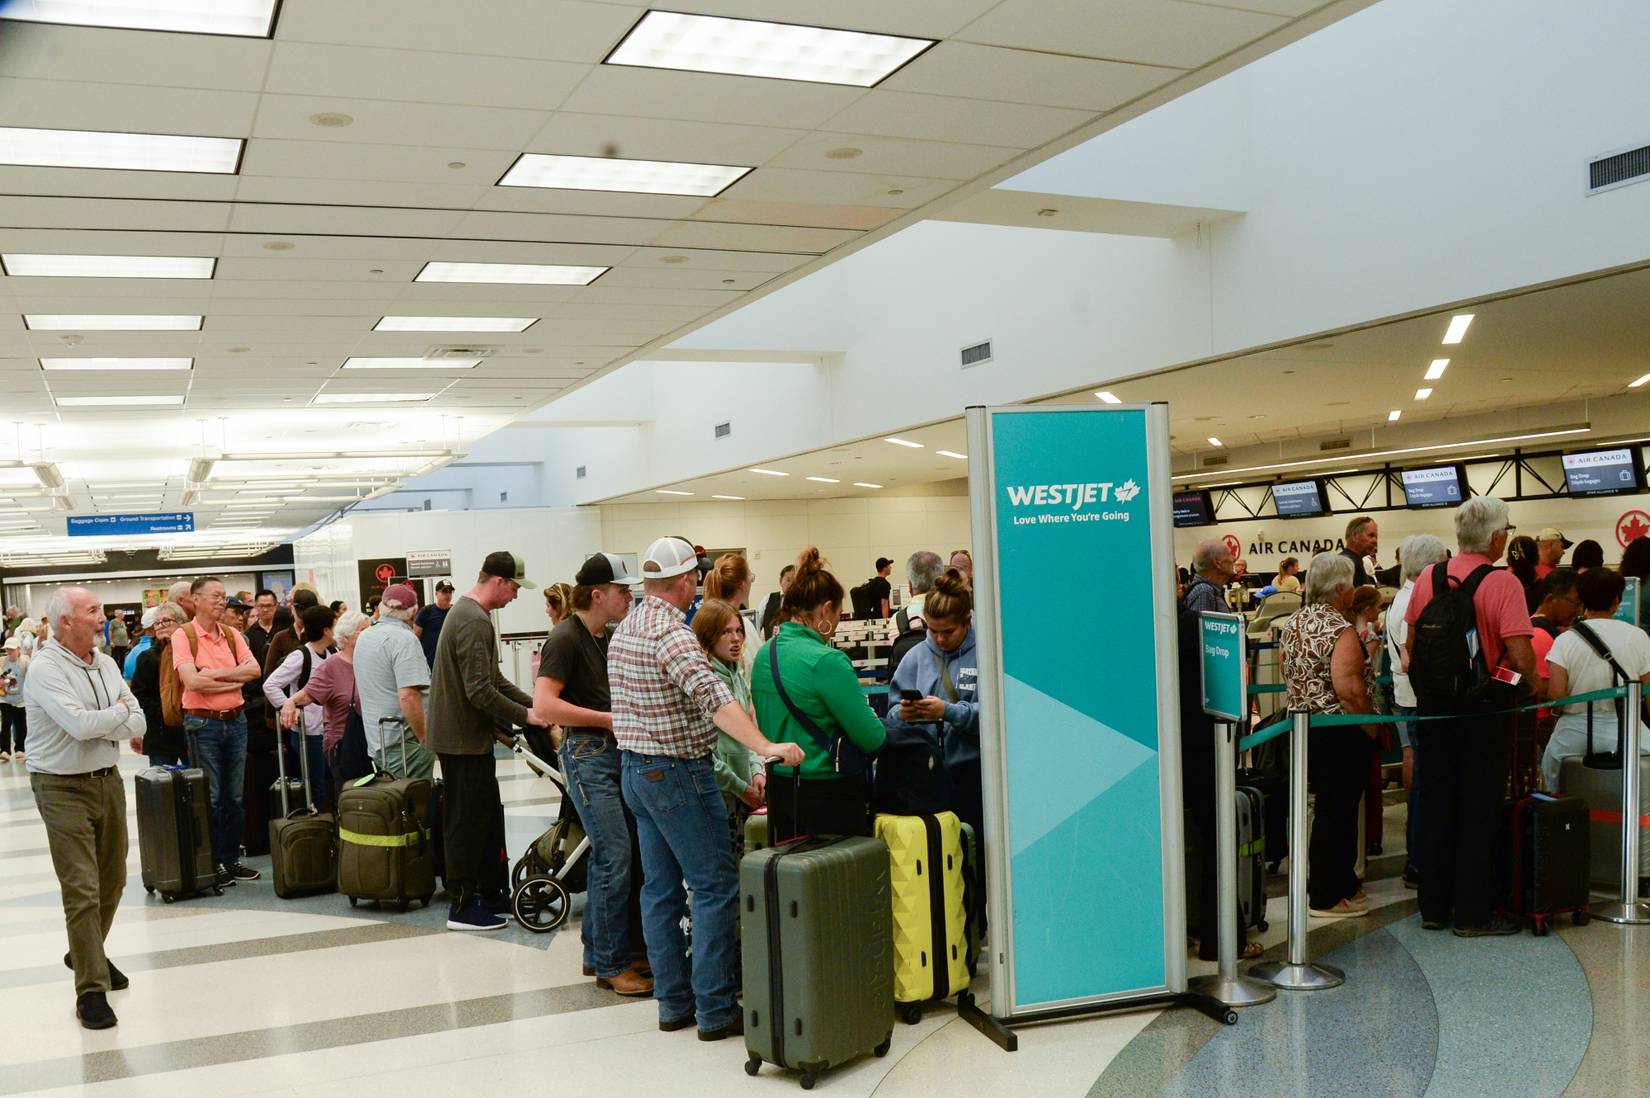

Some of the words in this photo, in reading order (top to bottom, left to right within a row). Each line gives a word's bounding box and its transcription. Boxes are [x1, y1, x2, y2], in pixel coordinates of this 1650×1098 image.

[1592, 453, 1627, 463] CANADA
[1425, 471, 1454, 479] CANADA
[1291, 484, 1314, 492] CANADA
[1006, 482, 1114, 511] WESTJET
[1013, 515, 1037, 525] Love
[1038, 513, 1070, 524] Where
[1102, 510, 1130, 522] Going
[1249, 541, 1274, 555] AIR
[1277, 538, 1345, 554] CANADA
[1204, 621, 1230, 635] WESTJET
[1205, 644, 1216, 656] Bag
[1216, 645, 1230, 659] Drop
